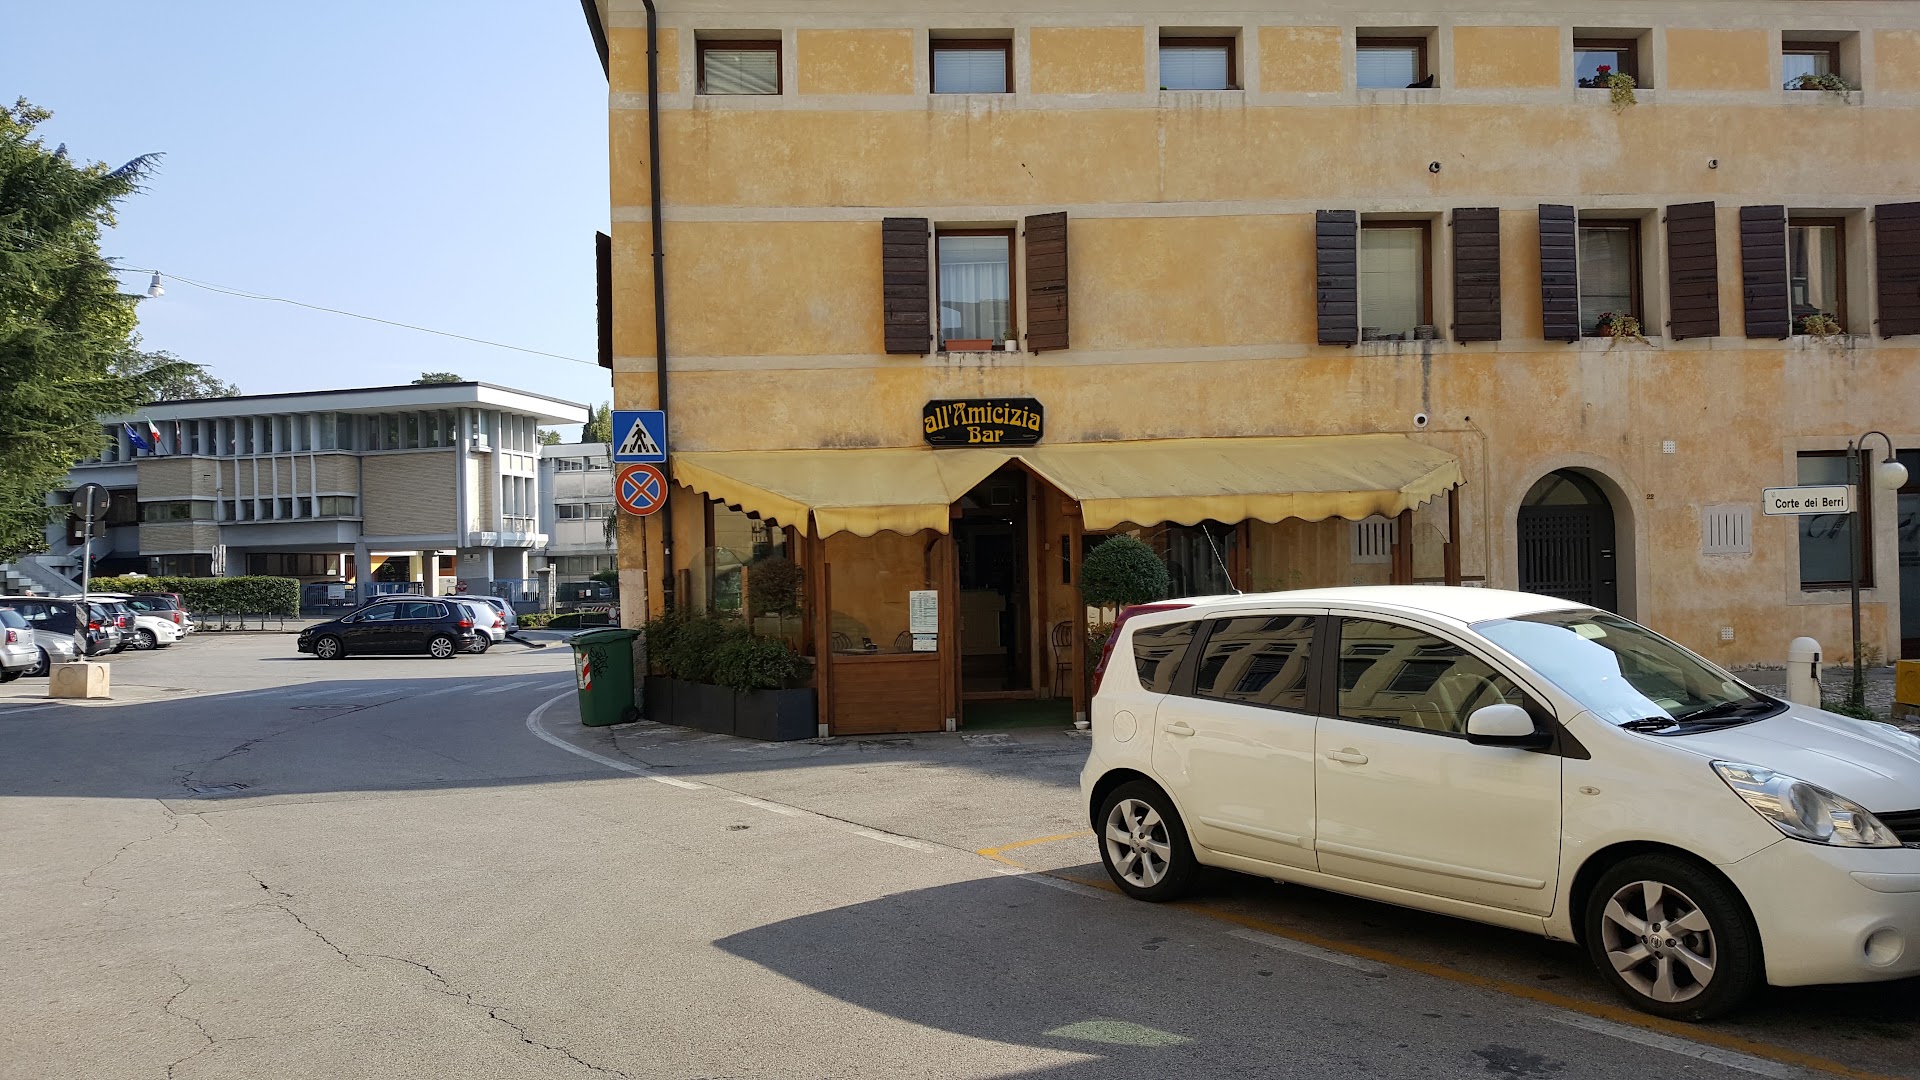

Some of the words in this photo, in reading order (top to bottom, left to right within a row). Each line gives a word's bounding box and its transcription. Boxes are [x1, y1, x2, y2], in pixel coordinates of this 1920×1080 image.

[924, 402, 1041, 433] all'Amicizia
[967, 426, 1004, 443] Bar
[1775, 498, 1800, 508] Corte
[1804, 498, 1818, 508] dei
[1822, 497, 1844, 507] Berri
